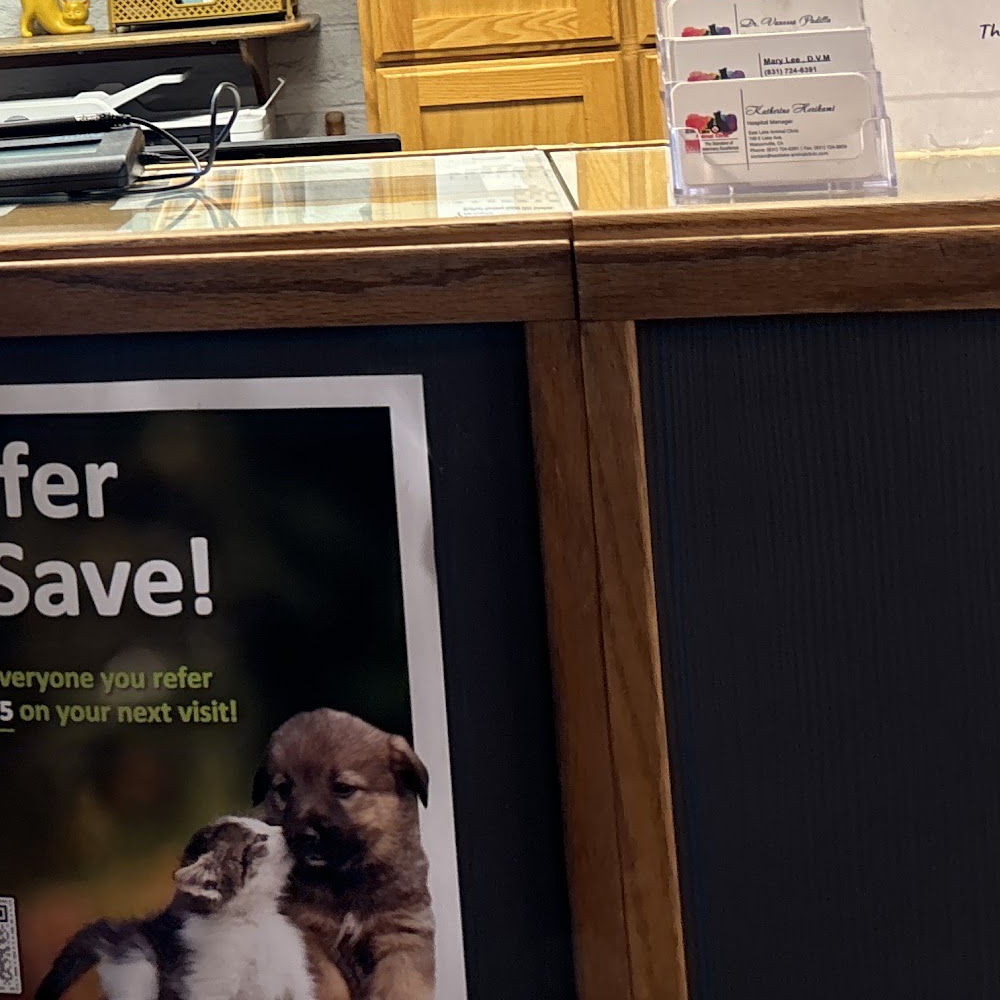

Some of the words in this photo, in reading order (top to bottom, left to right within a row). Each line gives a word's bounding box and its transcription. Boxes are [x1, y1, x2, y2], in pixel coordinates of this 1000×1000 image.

[799, 14, 831, 27] Padilla
[763, 57, 783, 66] Mary
[807, 54, 831, 62] D.V.M
[764, 68, 783, 76] (831)
[784, 66, 817, 74] 724-6391
[745, 104, 790, 116] Katherine
[100, 669, 145, 694] you
[153, 665, 213, 689] refer
[19, 702, 51, 723] on
[55, 702, 111, 727] your
[118, 701, 172, 724] next
[178, 699, 239, 724] visit!
